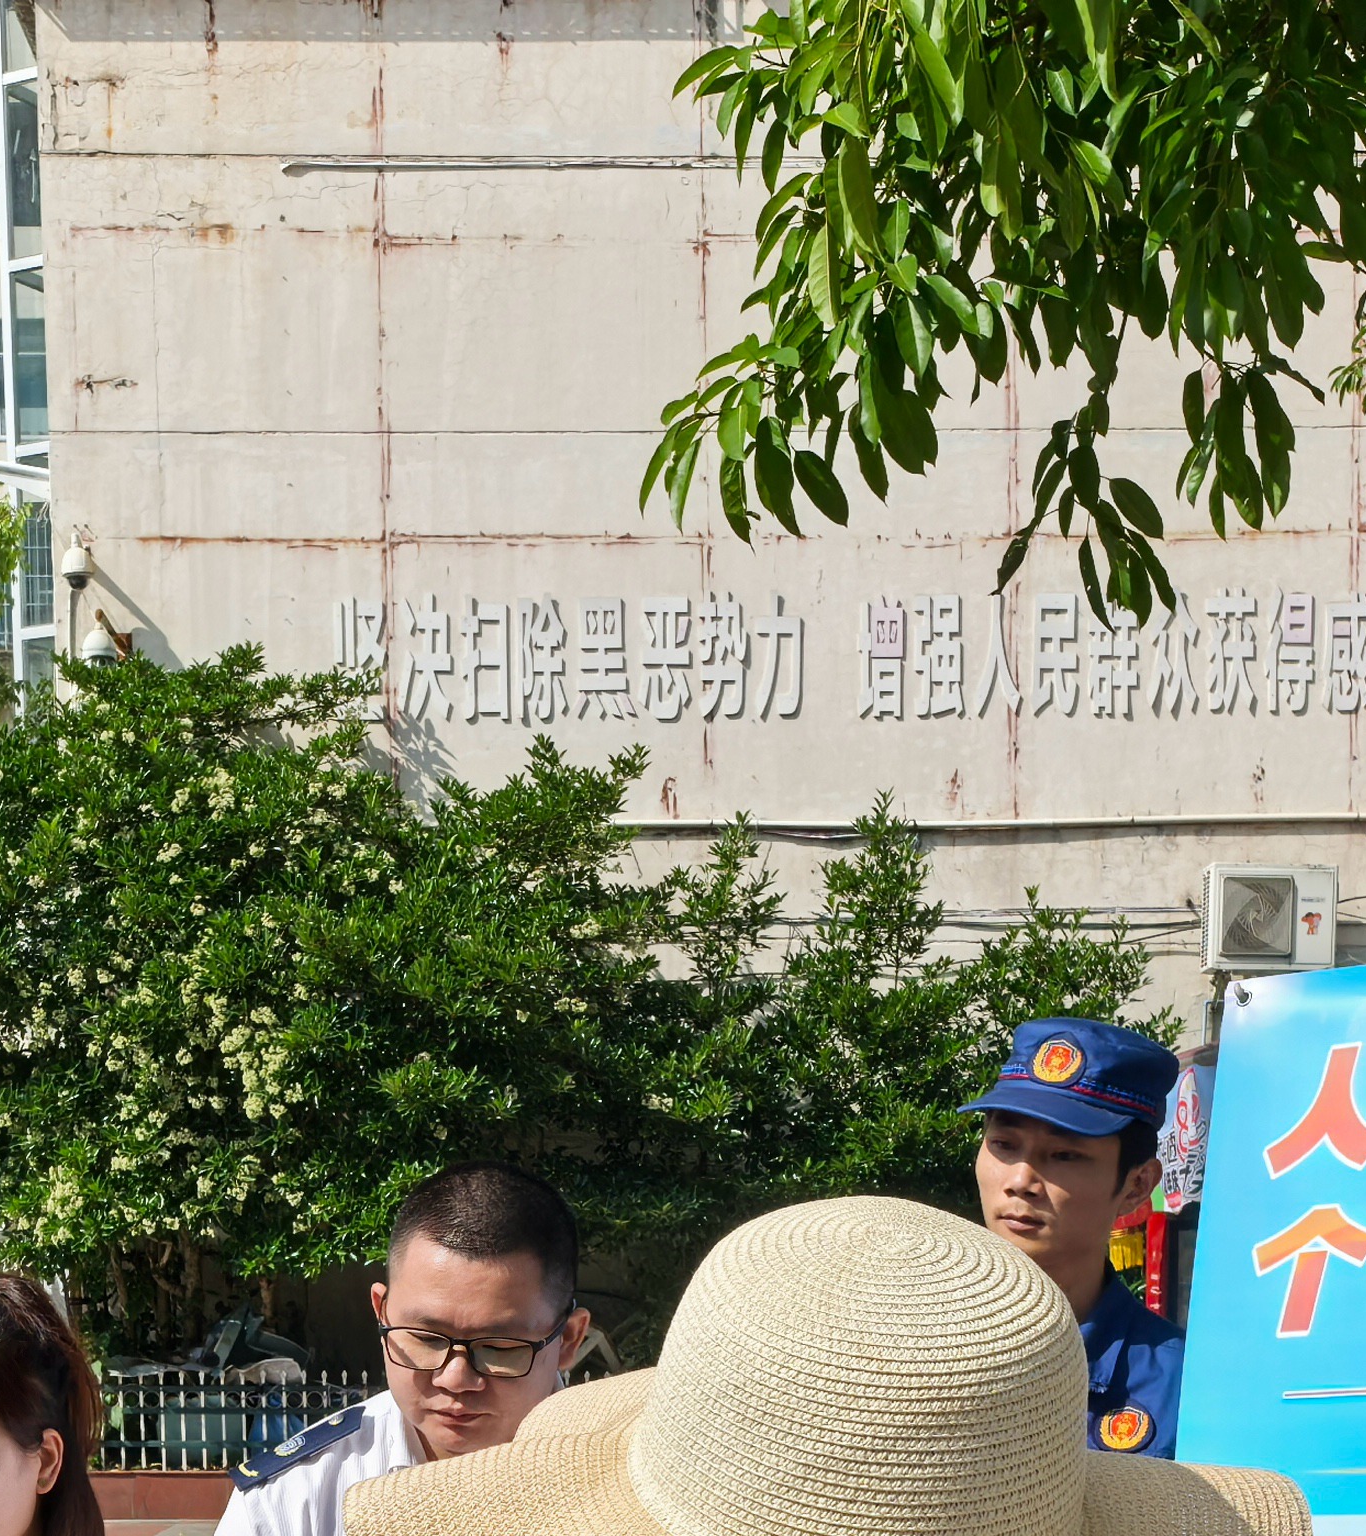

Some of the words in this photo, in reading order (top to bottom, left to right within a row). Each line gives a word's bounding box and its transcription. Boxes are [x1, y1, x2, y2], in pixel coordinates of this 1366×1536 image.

[334, 593, 804, 722] 坚决扫除黑恶势力
